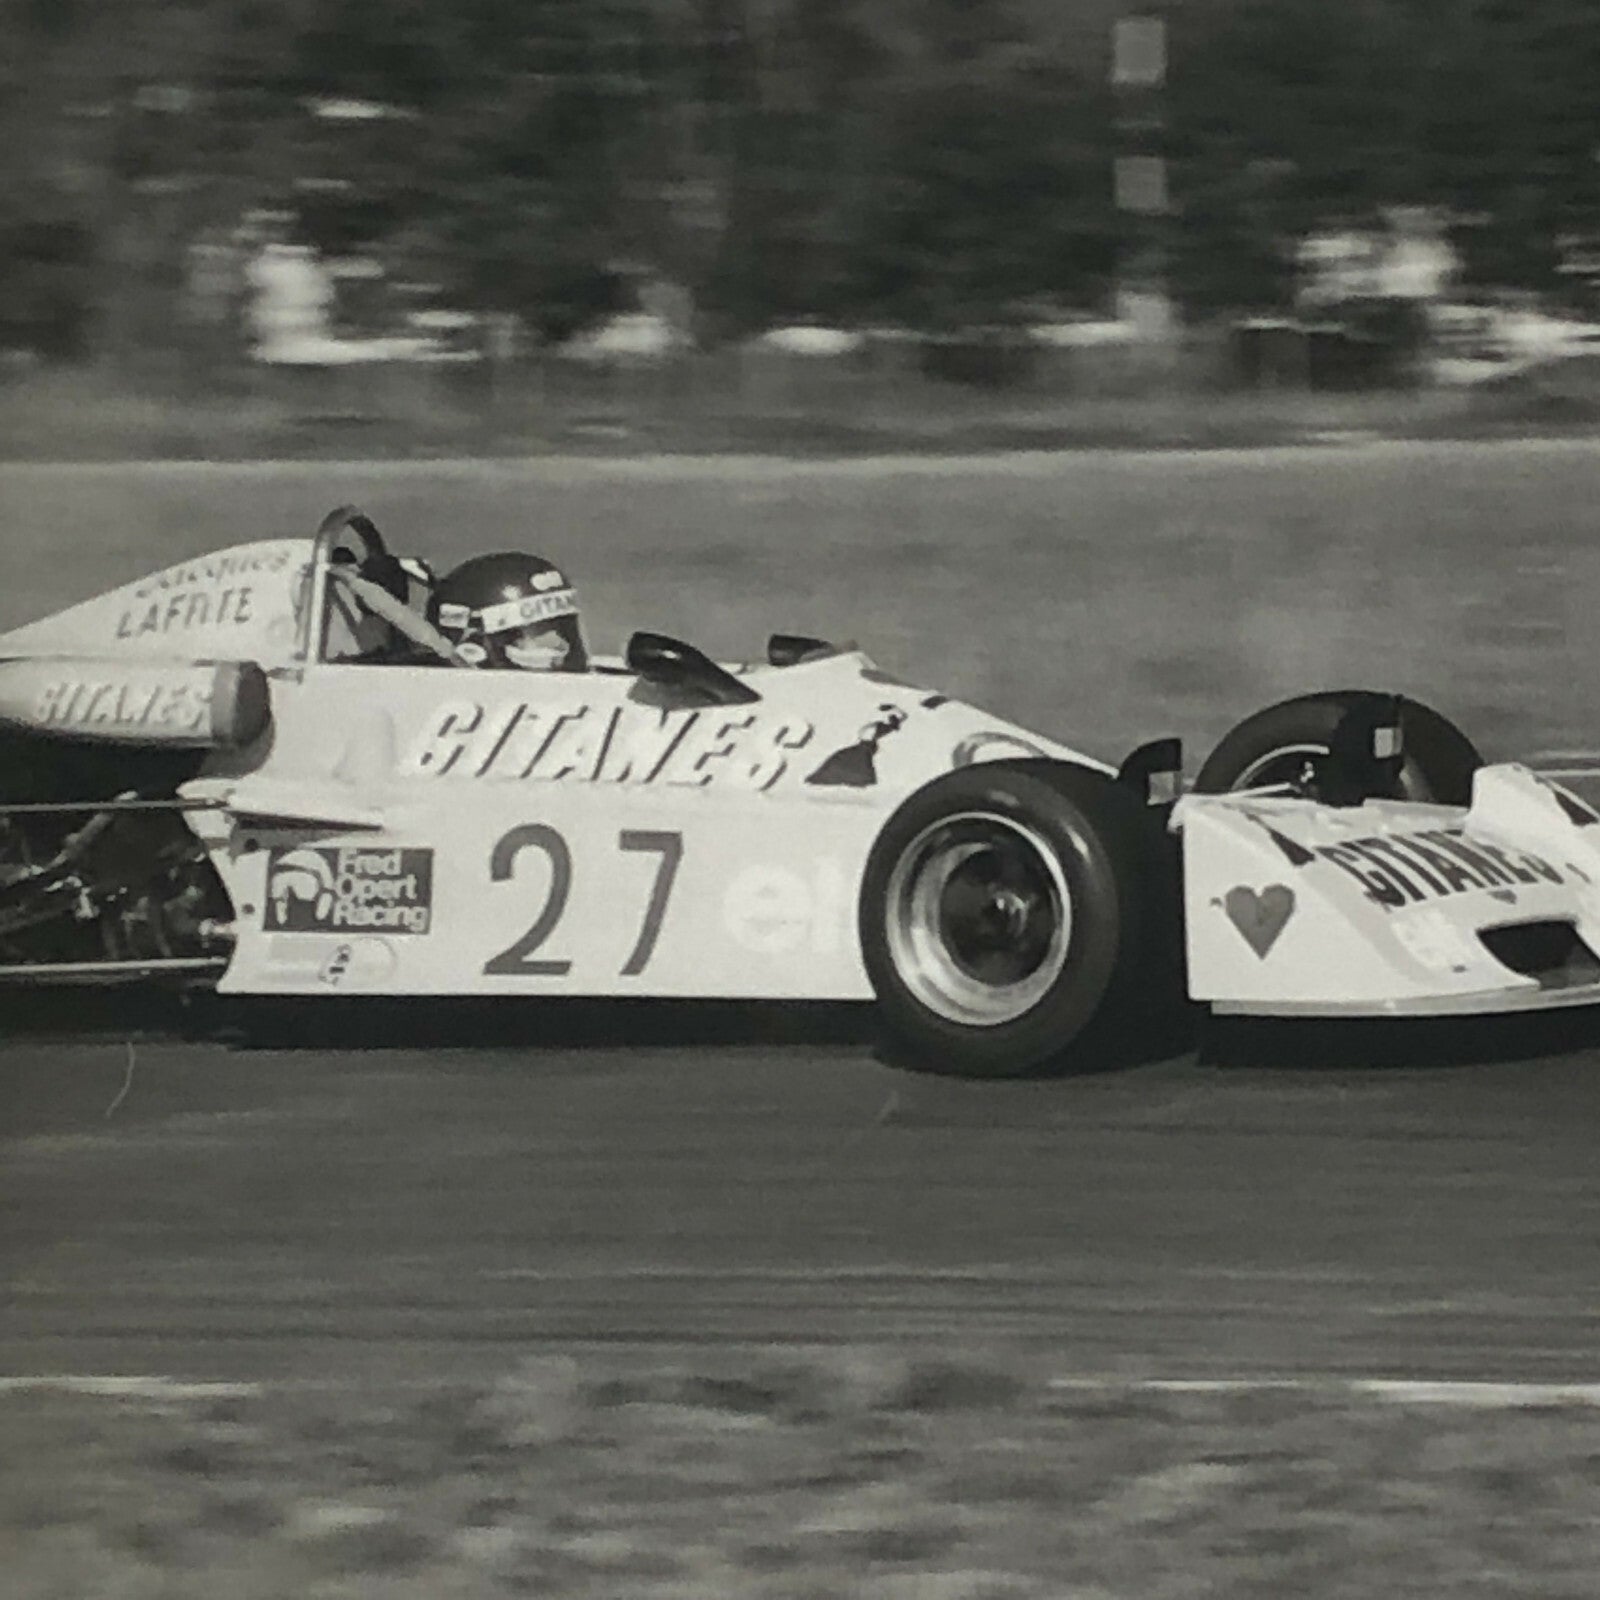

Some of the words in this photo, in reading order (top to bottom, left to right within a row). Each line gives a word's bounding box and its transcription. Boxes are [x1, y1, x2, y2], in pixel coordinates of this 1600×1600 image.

[401, 699, 816, 793] GITANES
[339, 848, 403, 876] Fred
[334, 872, 418, 904] Opert
[482, 822, 684, 976] 27
[333, 898, 428, 932] Racing
